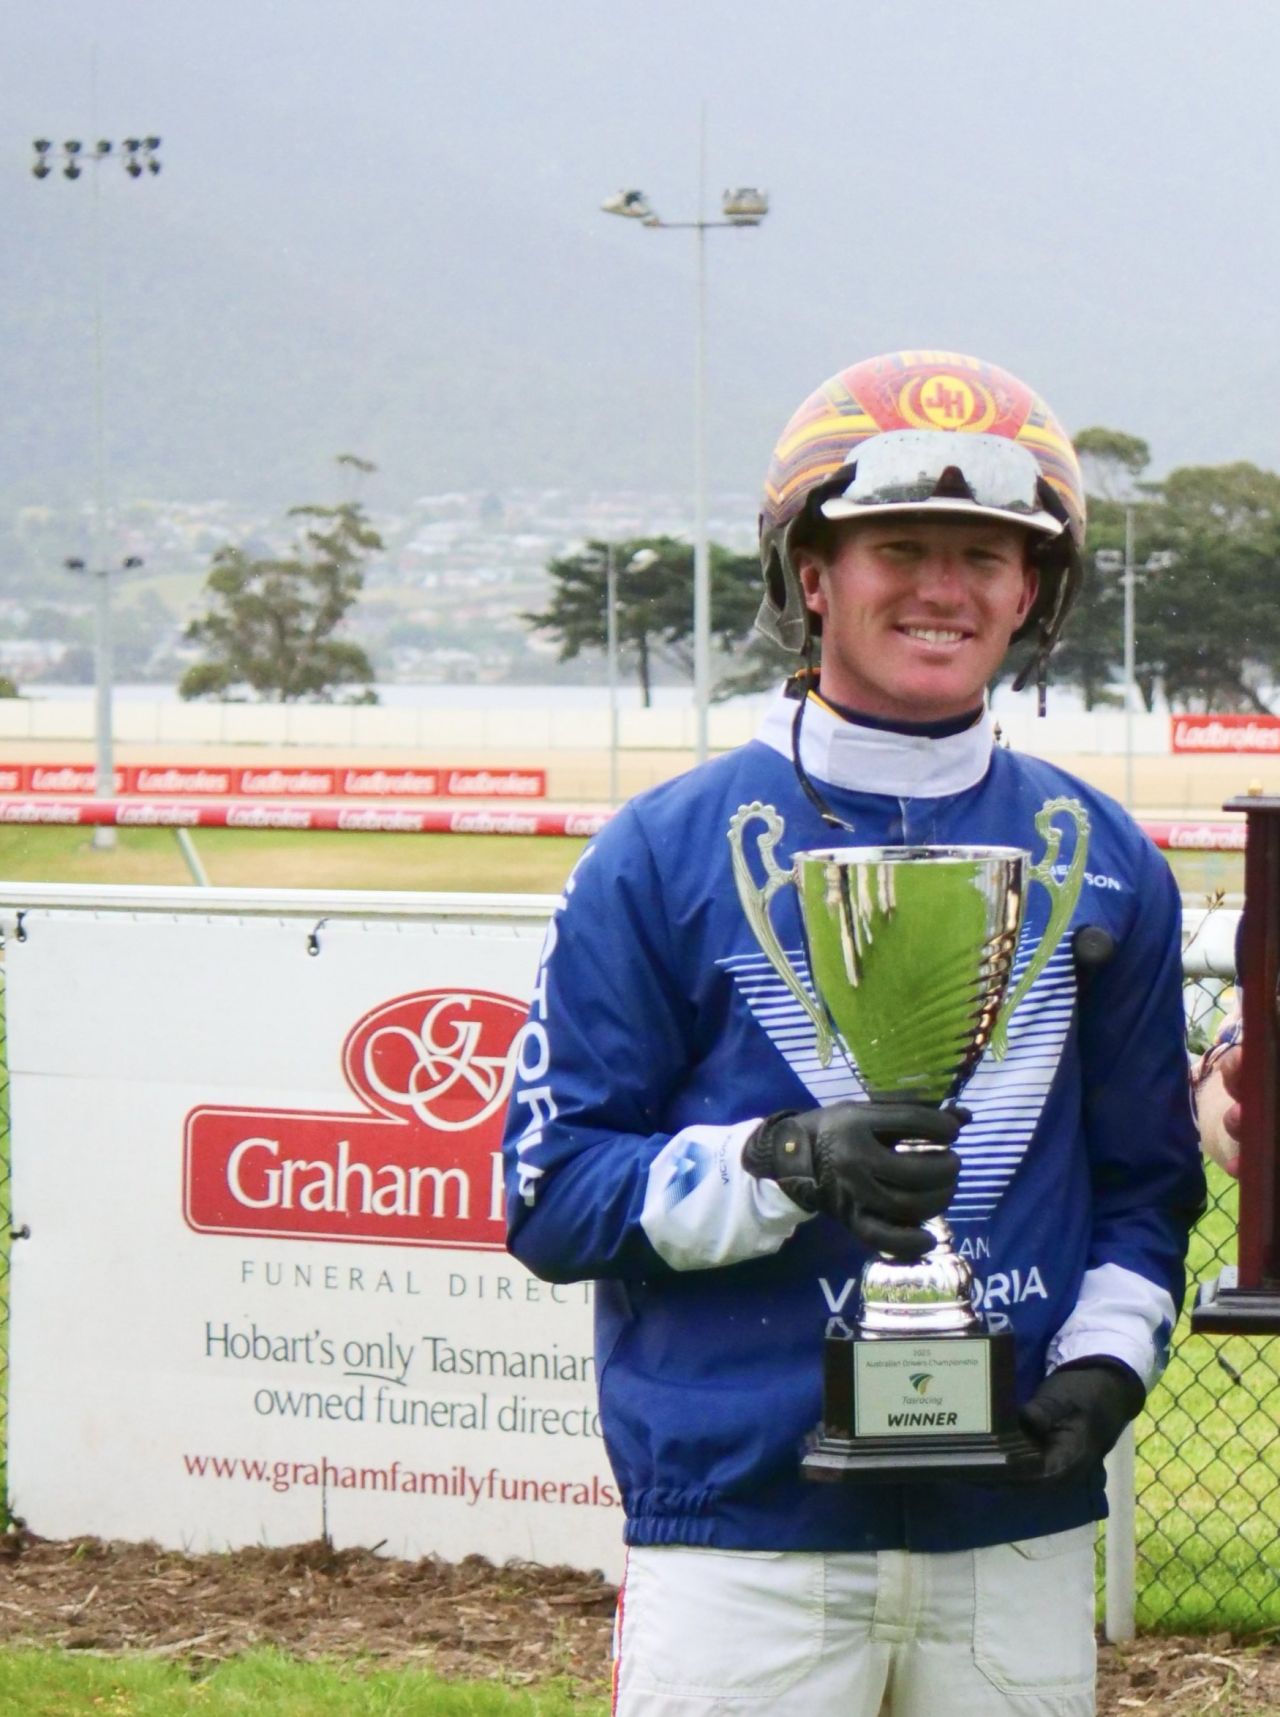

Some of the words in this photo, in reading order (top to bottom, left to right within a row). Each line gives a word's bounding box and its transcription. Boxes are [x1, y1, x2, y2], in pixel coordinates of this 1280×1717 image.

[227, 1137, 469, 1220] Graham
[240, 1260, 421, 1294] FUNERAL
[449, 1274, 594, 1304] DIRECT
[205, 1321, 334, 1367] Hobart's
[344, 1332, 414, 1385] only
[254, 1385, 364, 1422] owned
[377, 1387, 487, 1431] funeral
[887, 1411, 958, 1428] WINNER
[184, 1453, 622, 1508] www.grahamfamilyfunerals.
